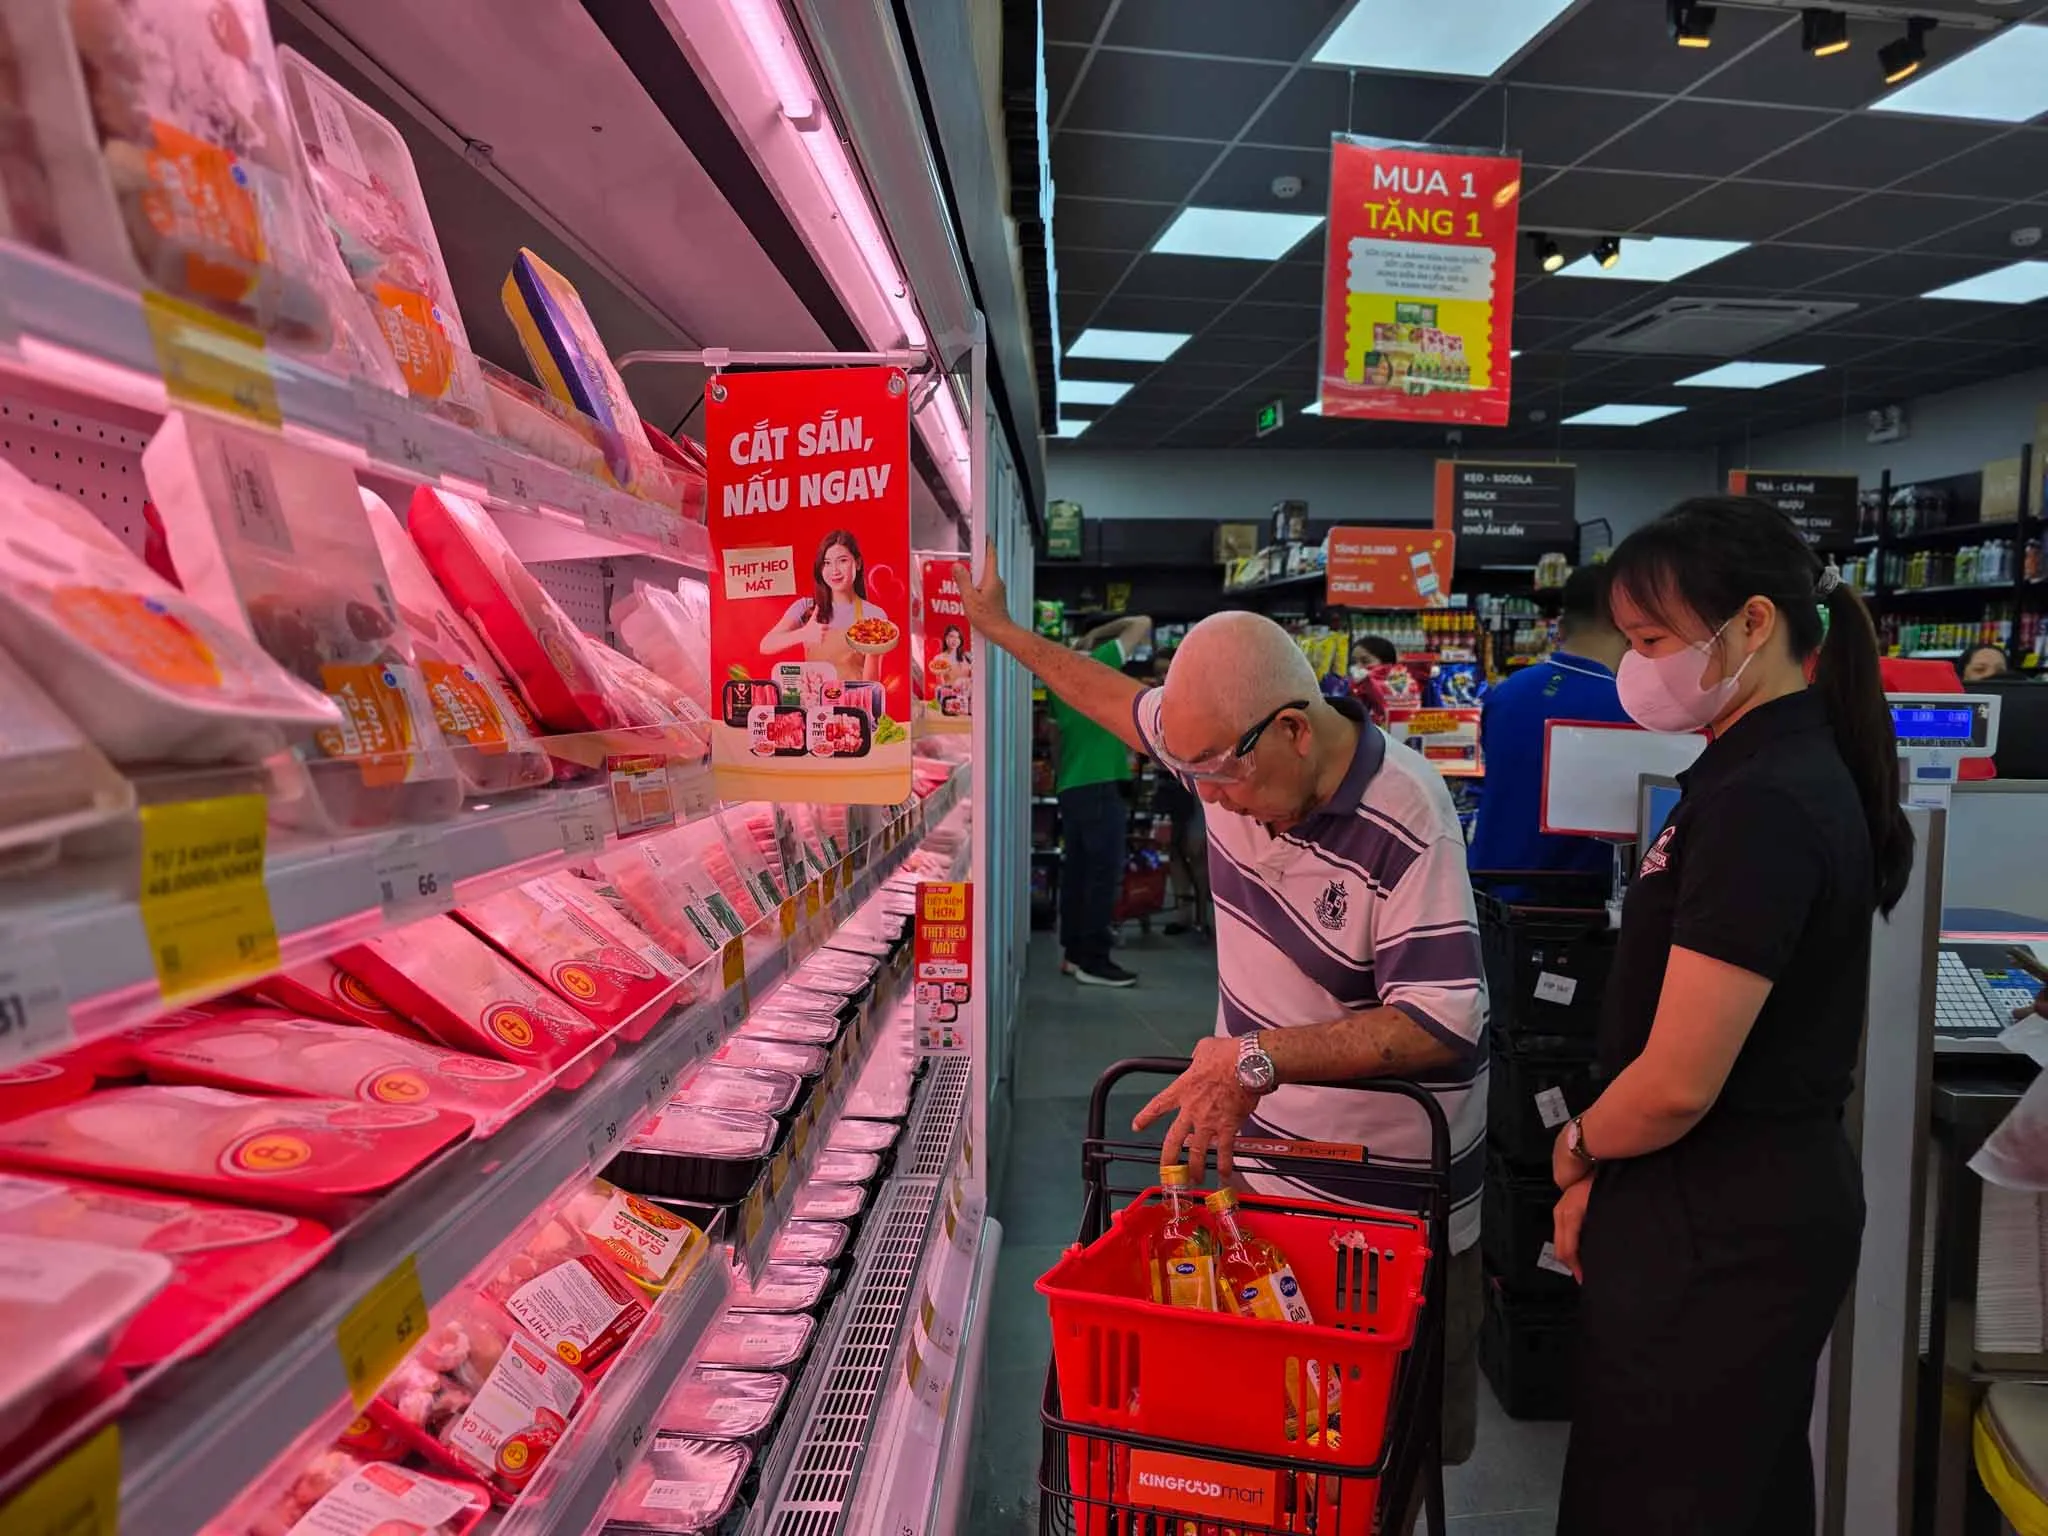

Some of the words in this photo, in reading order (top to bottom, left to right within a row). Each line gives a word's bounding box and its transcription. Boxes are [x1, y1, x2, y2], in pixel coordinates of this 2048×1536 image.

[1373, 163, 1449, 197] MUA
[1460, 172, 1478, 198] 1
[1364, 197, 1454, 238] TẶNG
[1465, 211, 1483, 238] 1
[729, 417, 790, 467] CẮT
[797, 408, 875, 459] SẴN,
[721, 467, 791, 518] NẤU
[799, 463, 893, 509] NGAY
[728, 561, 758, 580] THỊT
[760, 558, 789, 576] HEO
[745, 574, 774, 593] MÁT
[417, 873, 437, 897] 66
